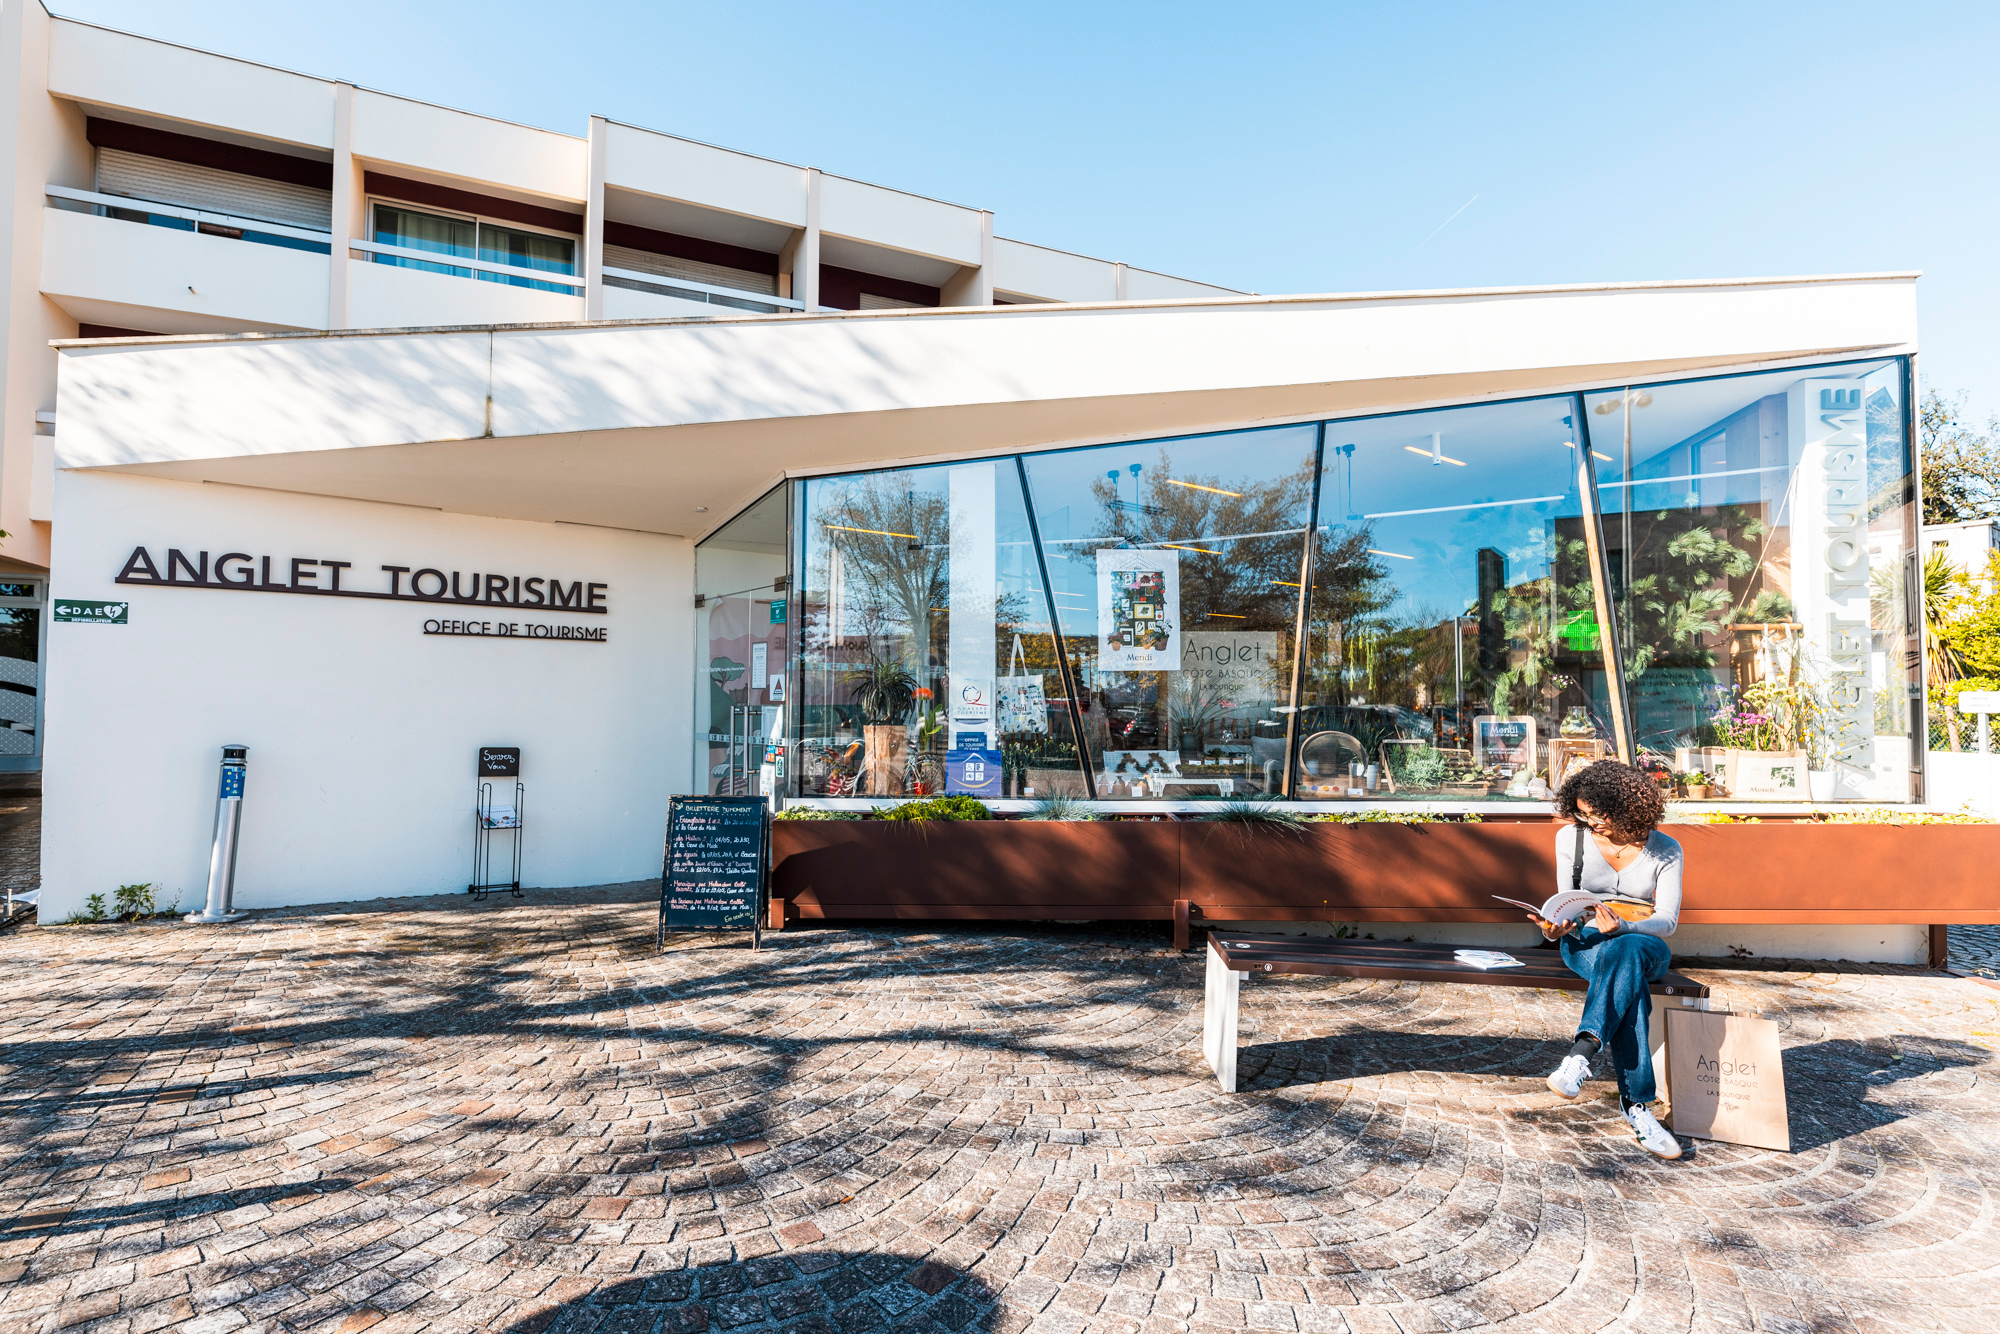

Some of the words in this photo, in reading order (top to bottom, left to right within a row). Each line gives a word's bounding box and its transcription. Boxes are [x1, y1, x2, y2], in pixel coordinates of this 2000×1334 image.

[116, 545, 352, 593] ANGLET
[381, 565, 608, 613] TOURISME
[72, 607, 103, 616] DAE
[423, 619, 491, 635] OFFICE
[498, 622, 519, 637] DE
[525, 624, 608, 640] TOURISME
[1183, 638, 1262, 666] Anglet
[1126, 653, 1153, 662] Mendi
[1218, 668, 1261, 679] BASQUE
[1200, 683, 1207, 691] LA
[1209, 683, 1244, 691] BOUTIQUE
[1490, 725, 1519, 733] Mendi
[1696, 1054, 1758, 1076] Anglet
[1724, 1078, 1759, 1088] BASQUE
[1716, 1091, 1751, 1100] BOUTIQUE
